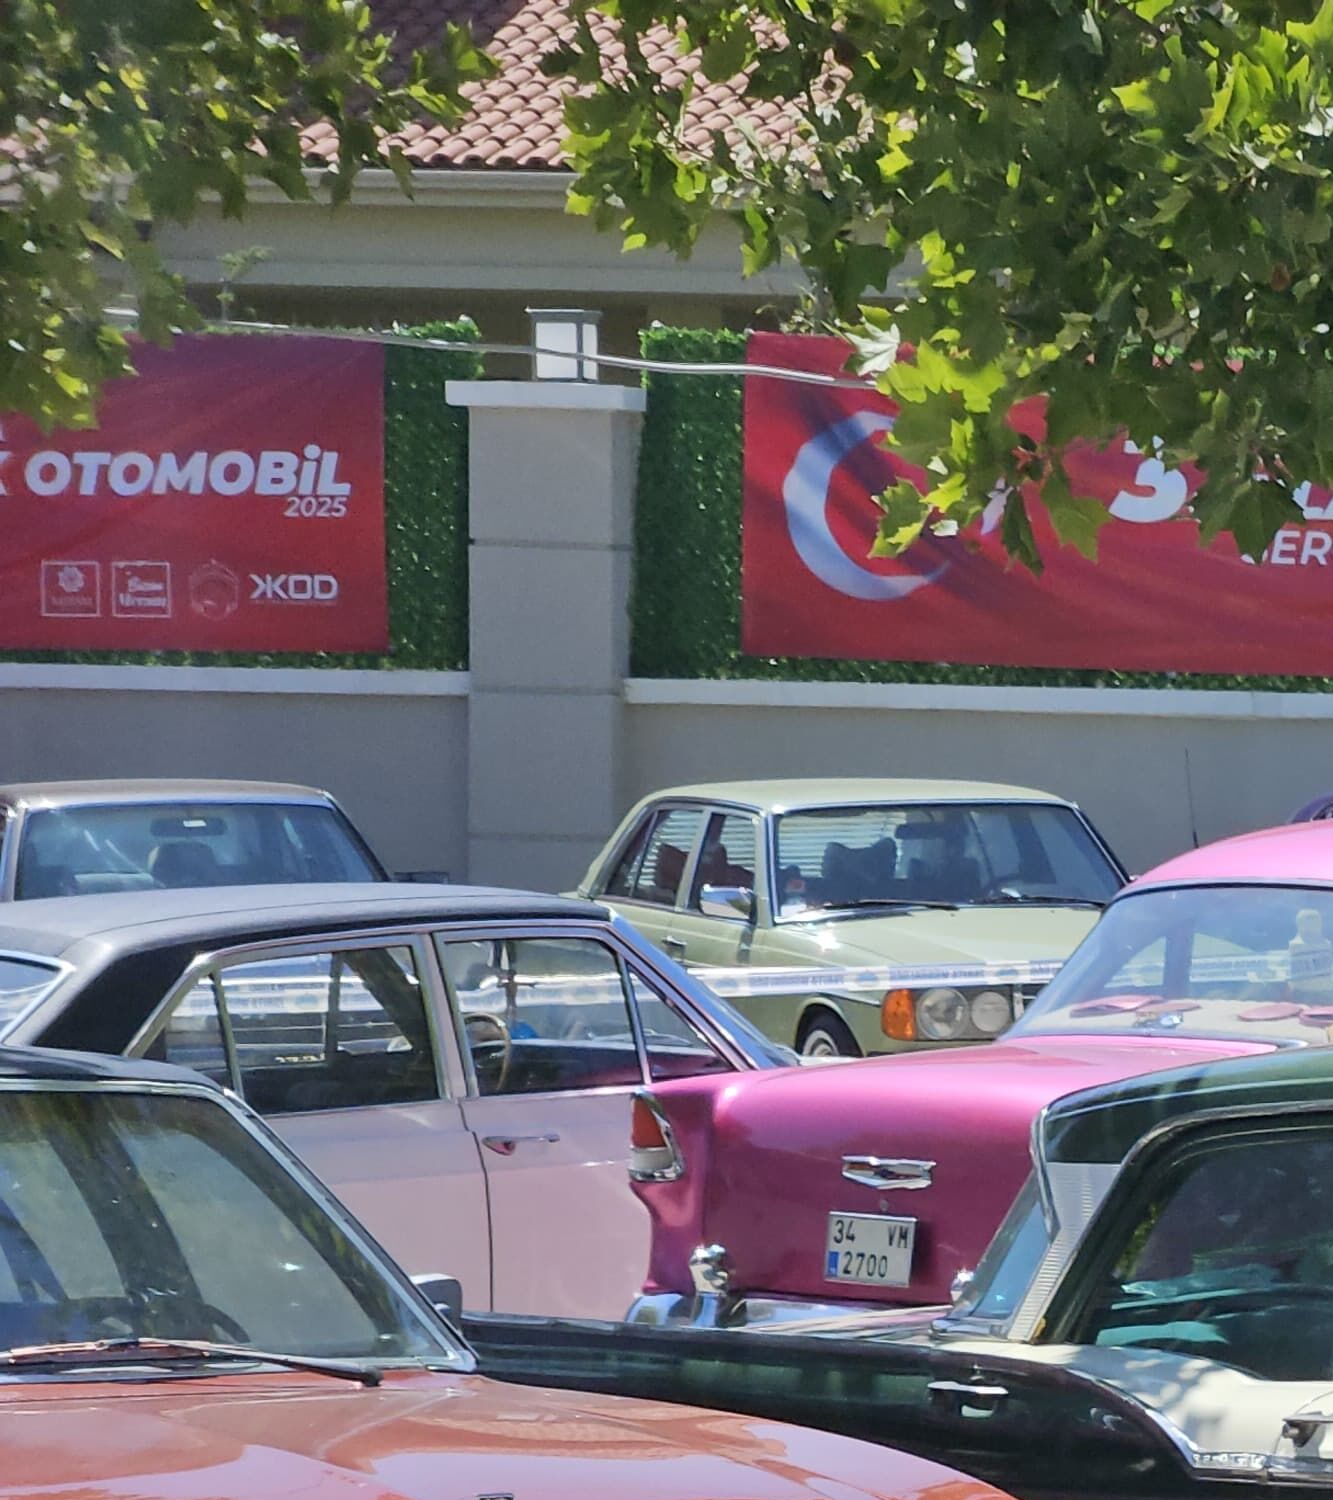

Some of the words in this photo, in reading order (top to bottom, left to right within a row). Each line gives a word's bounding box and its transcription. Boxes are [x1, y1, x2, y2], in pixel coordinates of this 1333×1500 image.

[284, 496, 348, 518] 2025
[833, 1220, 855, 1244] 34
[843, 1251, 888, 1278] 2700
